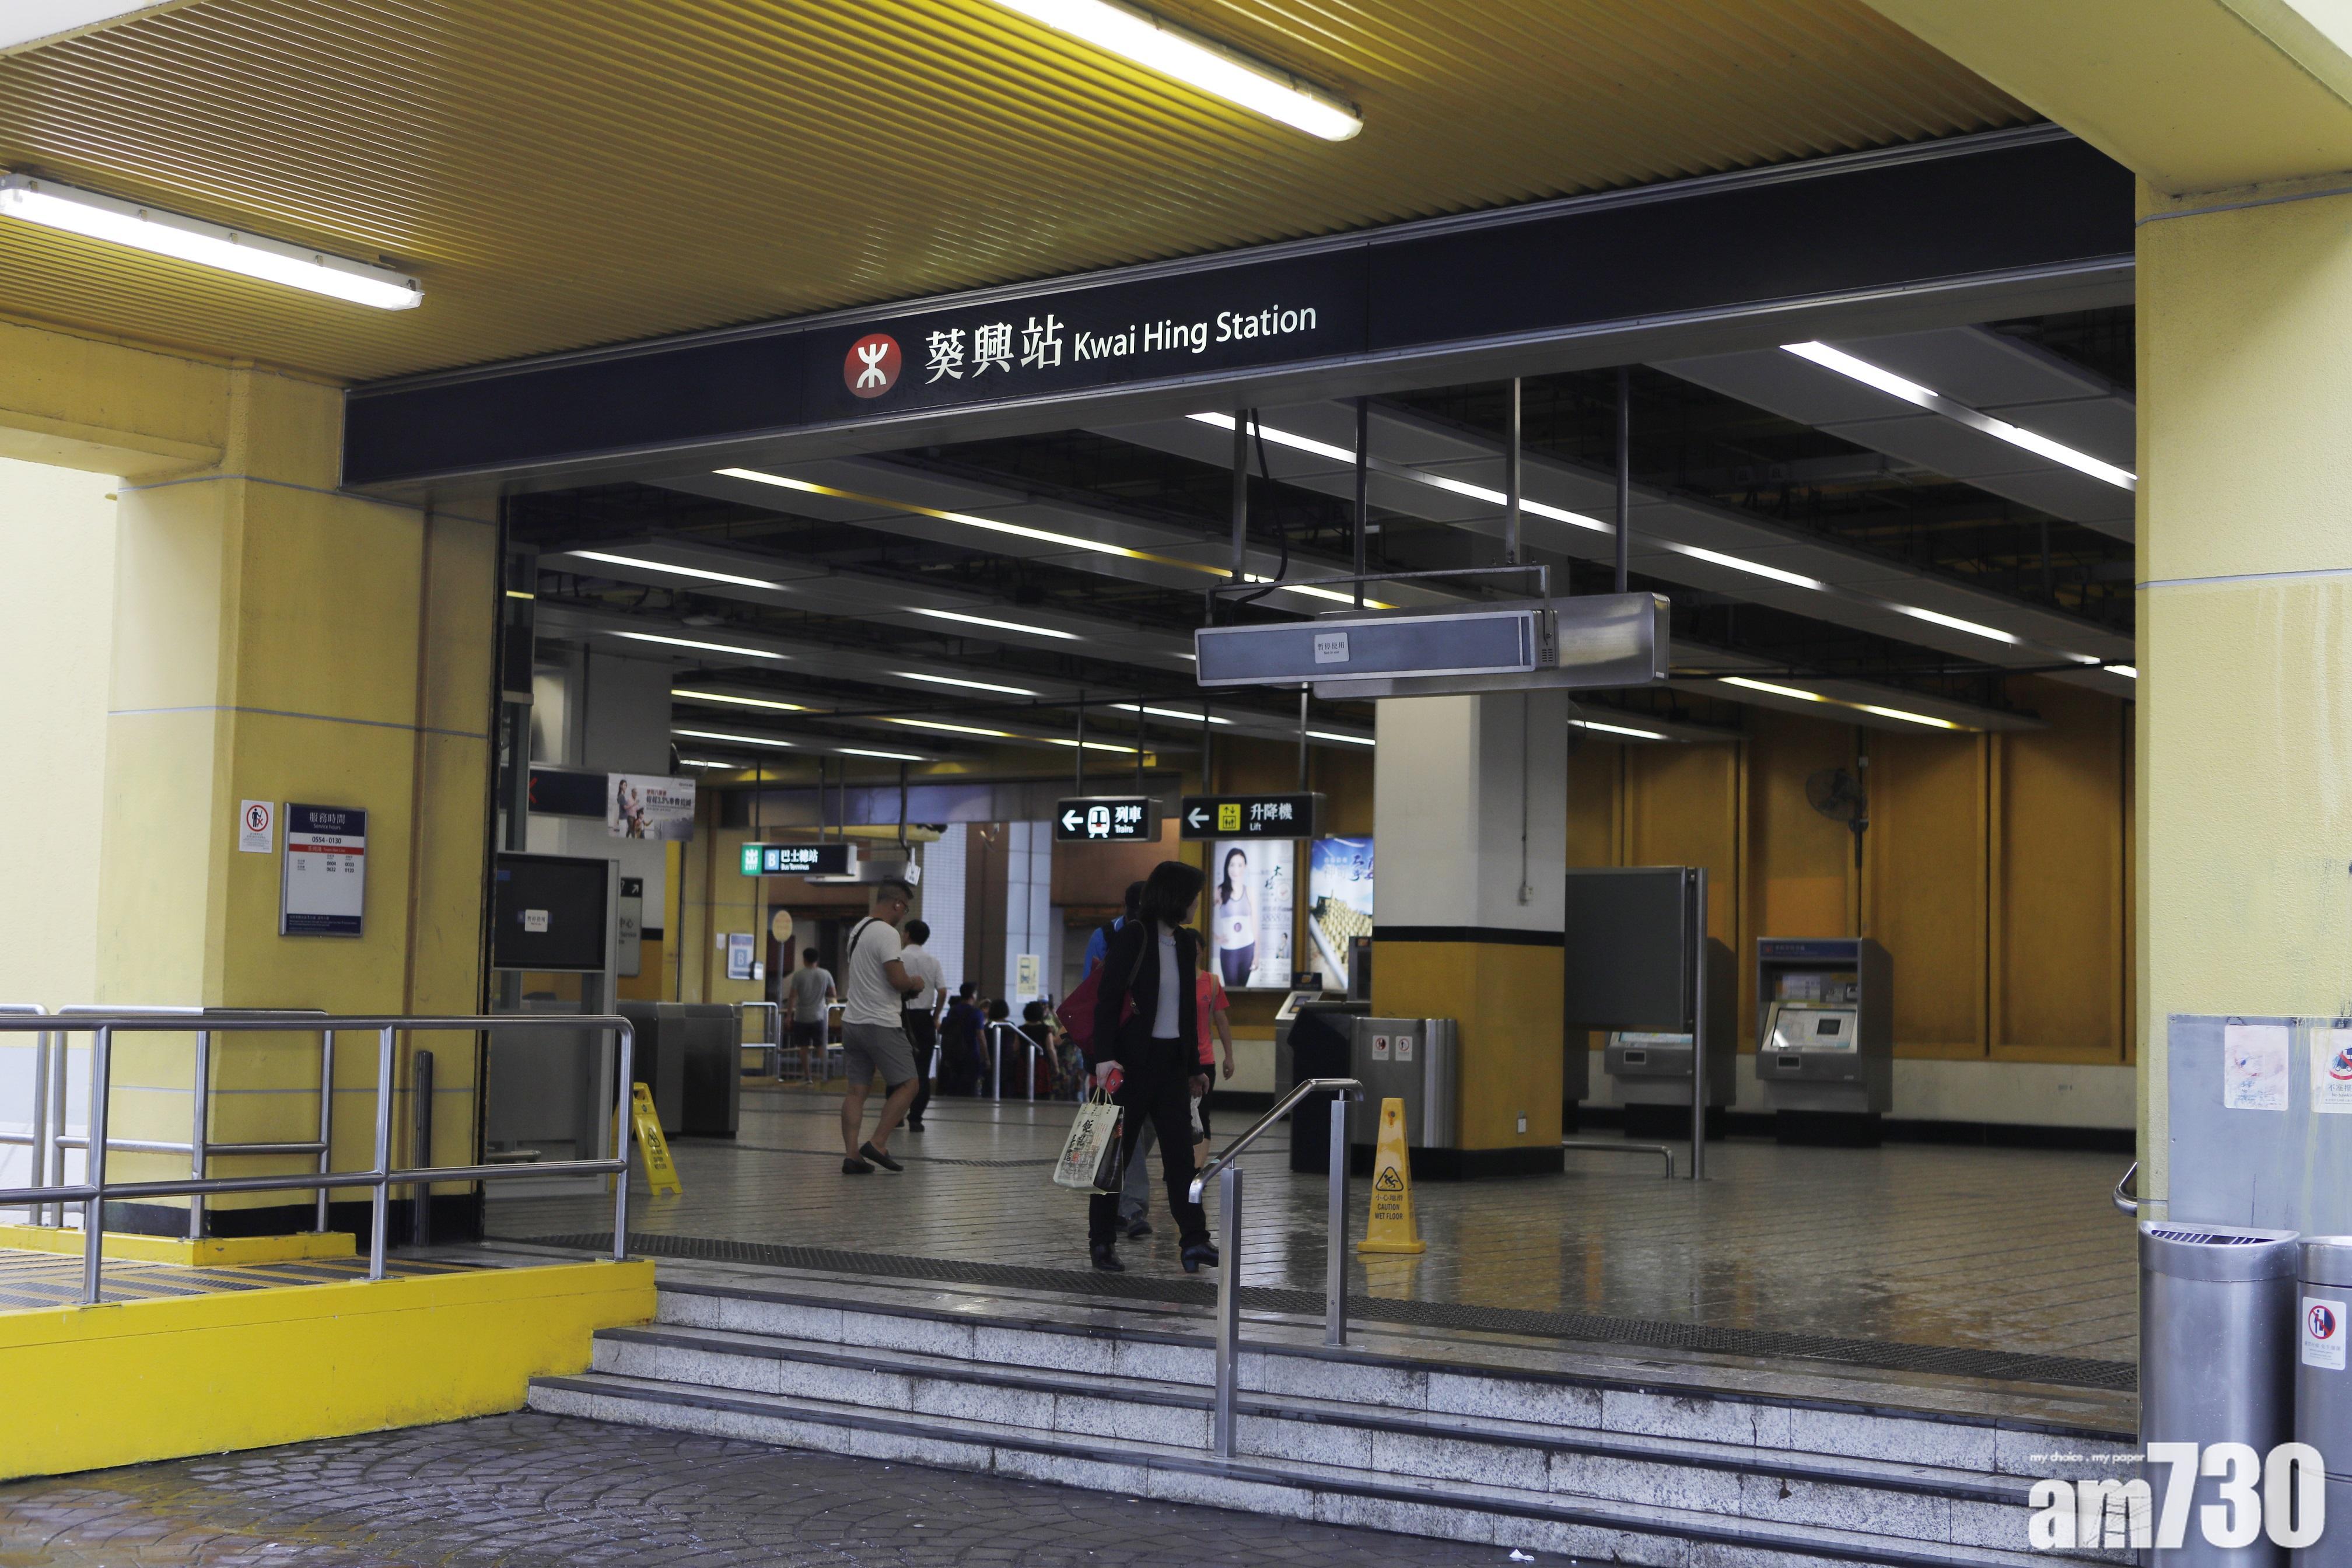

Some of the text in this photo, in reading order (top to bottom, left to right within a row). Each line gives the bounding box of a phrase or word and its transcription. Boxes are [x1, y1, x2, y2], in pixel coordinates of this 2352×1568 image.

[1074, 304, 1317, 361] Kwai Hing Station
[925, 314, 1065, 384] 葵興站
[310, 812, 345, 825] 服務時間
[1115, 806, 1142, 823] 列車
[1250, 803, 1293, 820] 升降機
[1115, 824, 1133, 834] Trains
[1250, 822, 1261, 831] Lift
[768, 853, 776, 867] B
